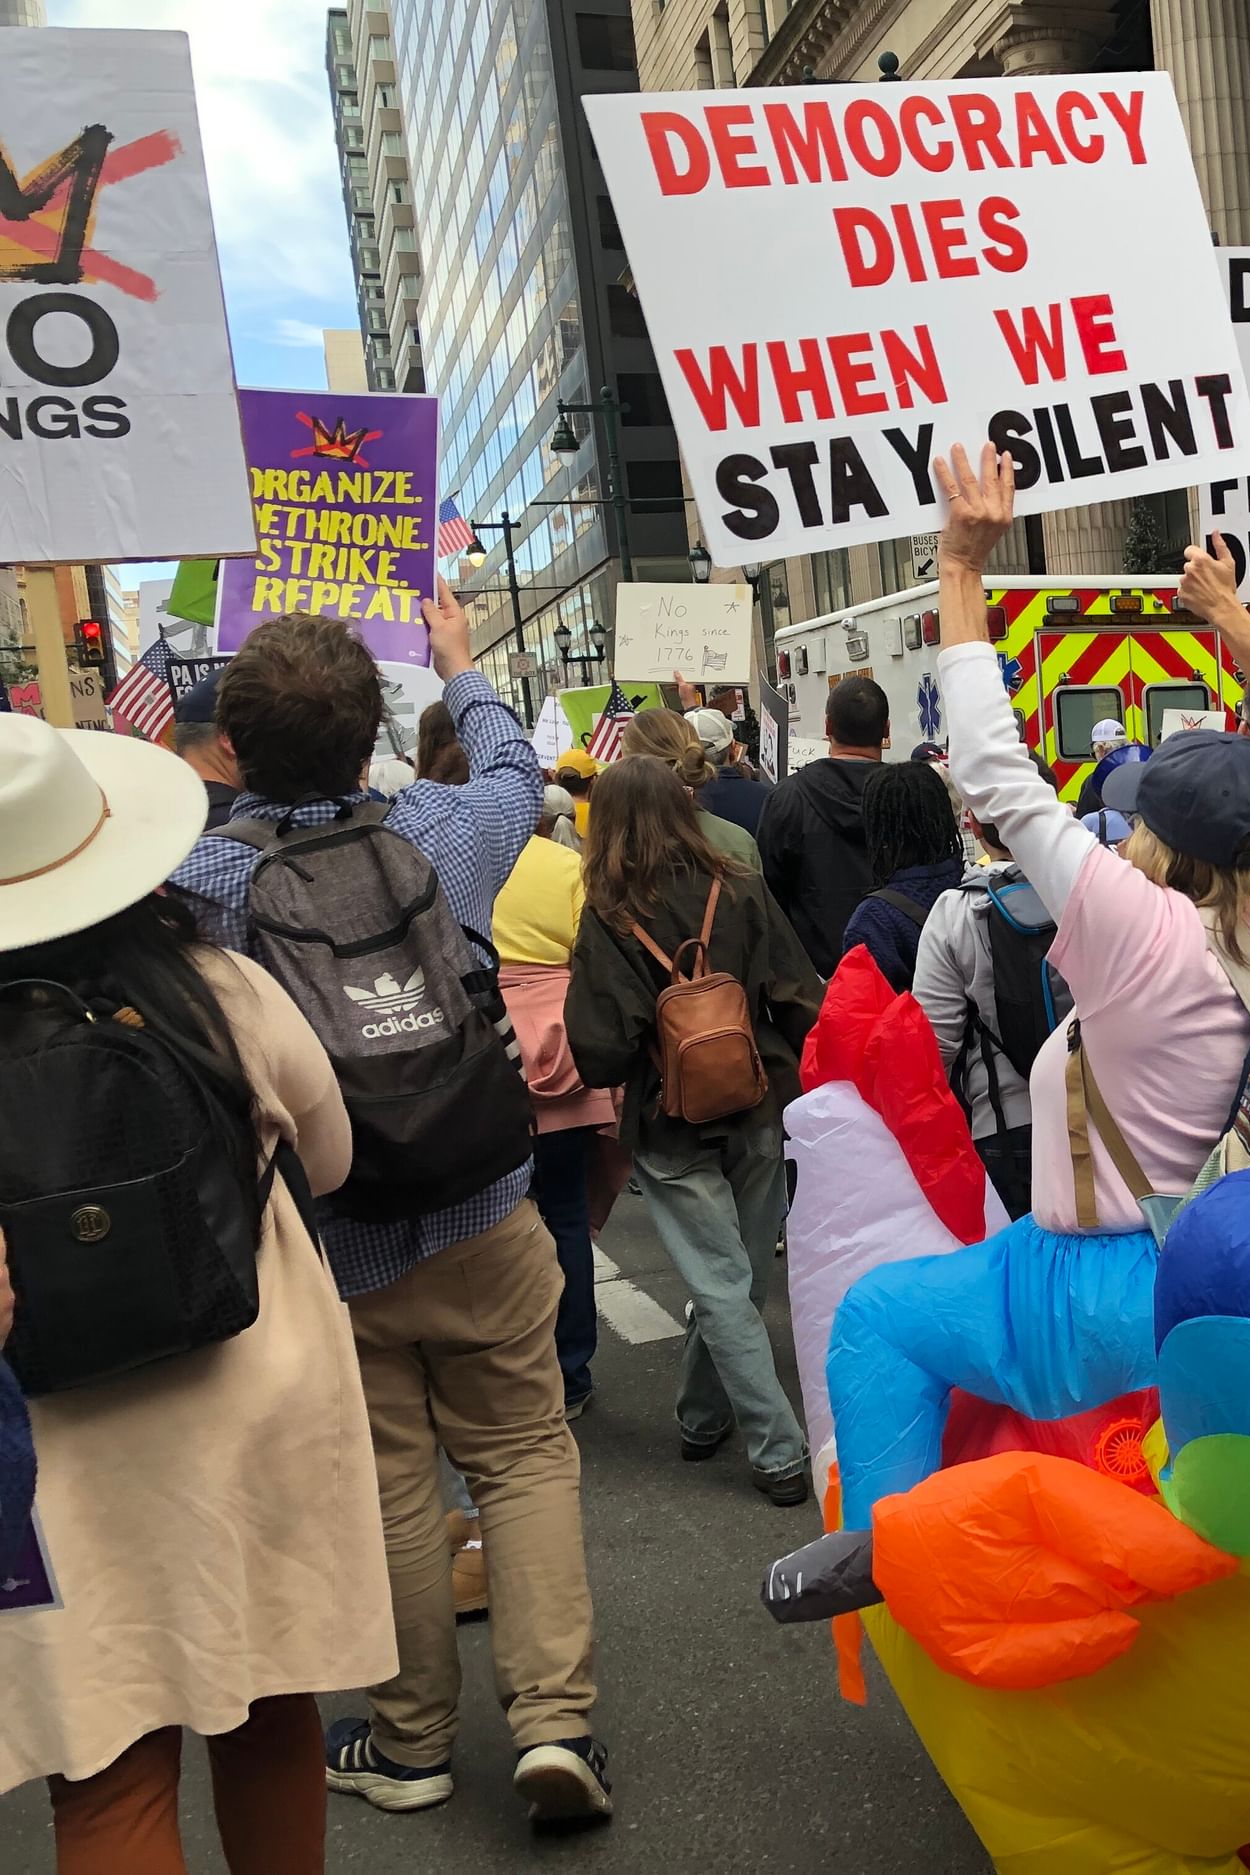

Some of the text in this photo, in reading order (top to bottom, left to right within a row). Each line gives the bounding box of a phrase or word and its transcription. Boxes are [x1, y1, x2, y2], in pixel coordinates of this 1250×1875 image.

[640, 90, 1148, 196] DEMOCRACY
[832, 195, 1029, 288] DIES
[5, 291, 119, 387] O
[674, 293, 1127, 431] WHEN WE
[715, 373, 1232, 540] STAY SILENT
[254, 503, 429, 549] ETHRONE.
[913, 535, 938, 545] BUSES
[255, 539, 408, 587] STRIKE.
[914, 545, 938, 556] BICY
[252, 576, 424, 624] REPEAT.
[658, 595, 687, 617] No
[654, 623, 731, 644] Kings since
[656, 647, 694, 662] 1776
[171, 665, 193, 686] PA
[362, 1007, 445, 1038] adidas
